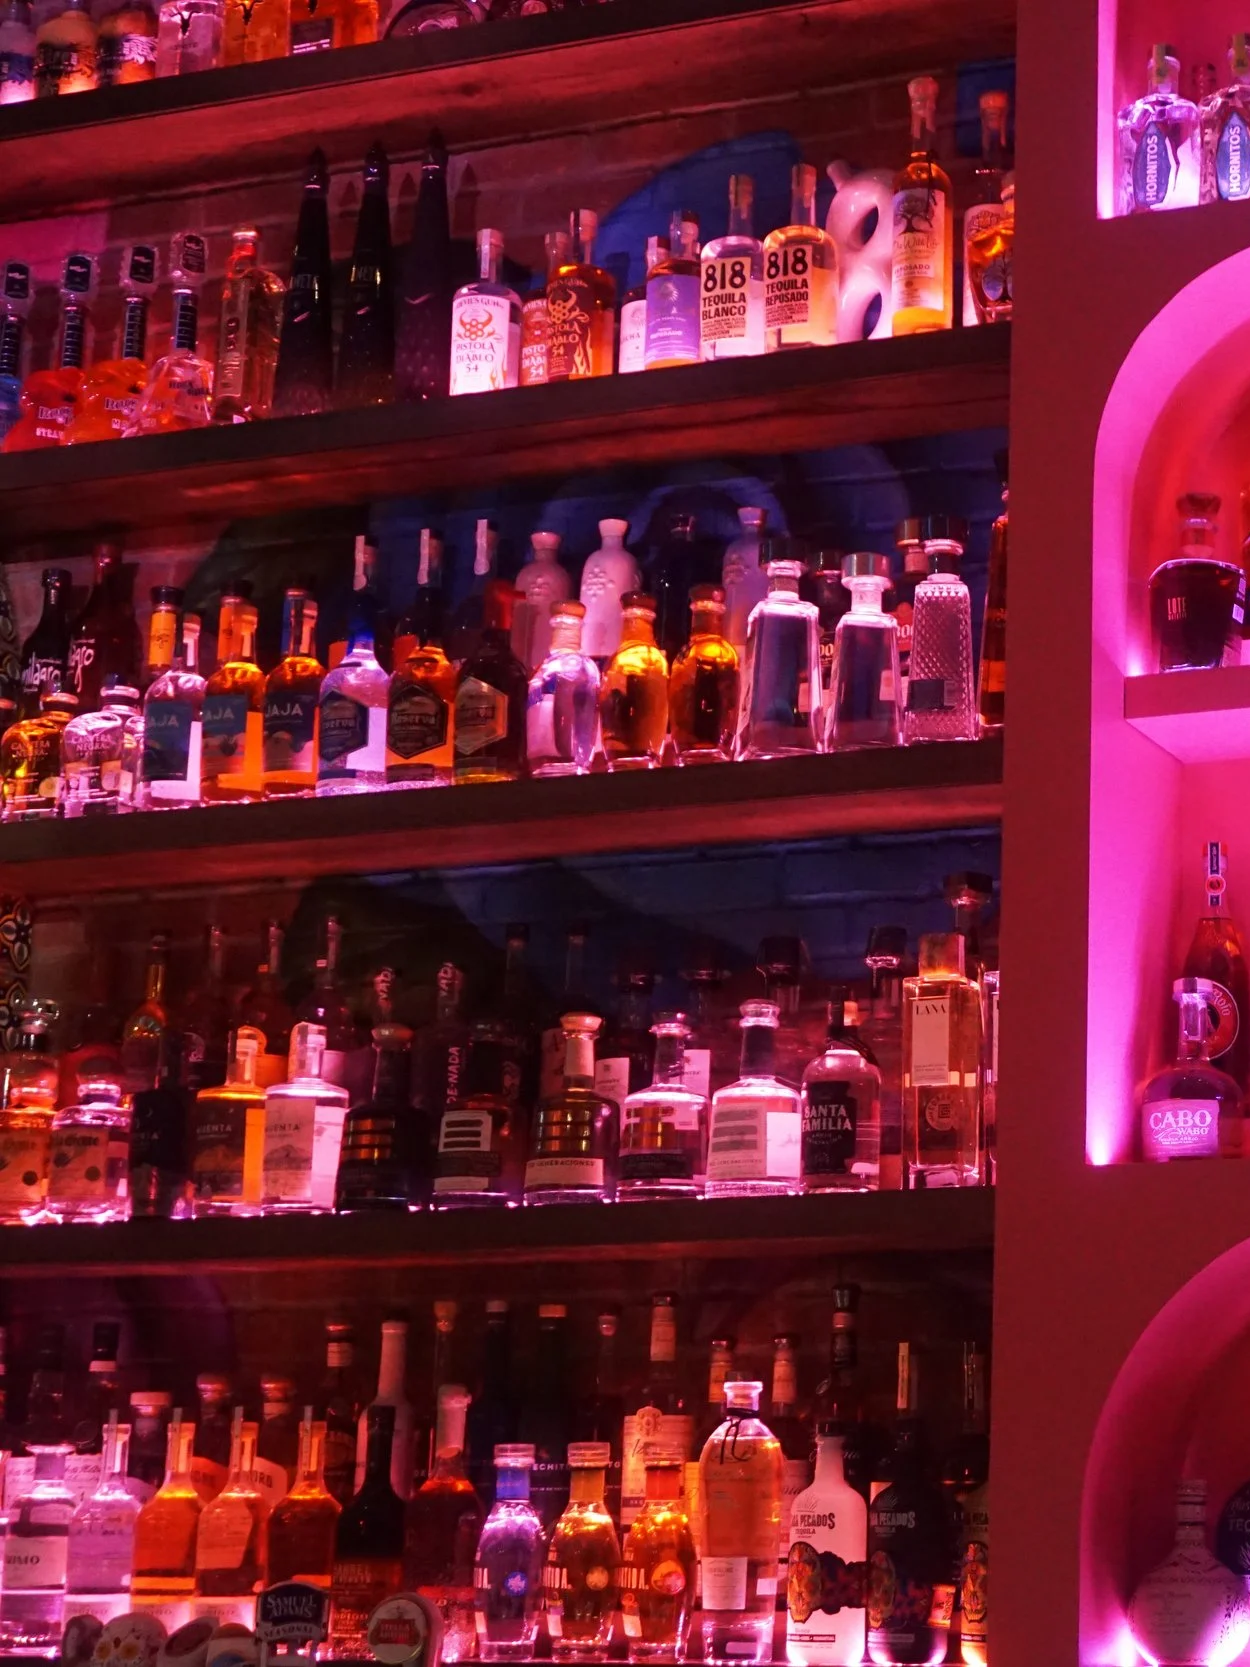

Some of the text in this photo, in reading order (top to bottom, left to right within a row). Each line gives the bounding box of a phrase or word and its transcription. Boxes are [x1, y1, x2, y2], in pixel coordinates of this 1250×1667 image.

[1229, 125, 1241, 194] HORNITOS
[1146, 135, 1159, 202] HORNITOS
[766, 248, 808, 280] 818
[703, 261, 747, 292] 818
[766, 278, 809, 294] TEQUILA
[702, 292, 747, 308] TEQUILA
[765, 291, 809, 306] REPOSADO
[702, 305, 746, 321] BLANCO
[456, 341, 496, 354] PISTOLA
[522, 344, 546, 356] PISTO
[552, 346, 564, 356] 54
[456, 353, 494, 364] DIABLO
[465, 364, 479, 373] 54
[530, 366, 544, 376] 54
[204, 707, 235, 721] AJA
[264, 703, 303, 718] JAJA
[148, 714, 179, 729] AJA
[323, 718, 355, 728] eserva
[804, 1104, 847, 1118] SANTA
[801, 1116, 853, 1132] FAMILIA
[1150, 1109, 1213, 1130] CABO
[1177, 1127, 1209, 1136] WABO
[800, 1512, 835, 1530] PECADOS
[878, 1511, 916, 1529] PECADOS
[267, 1594, 318, 1608] SAMUEL
[270, 1603, 314, 1620] ADAMS
